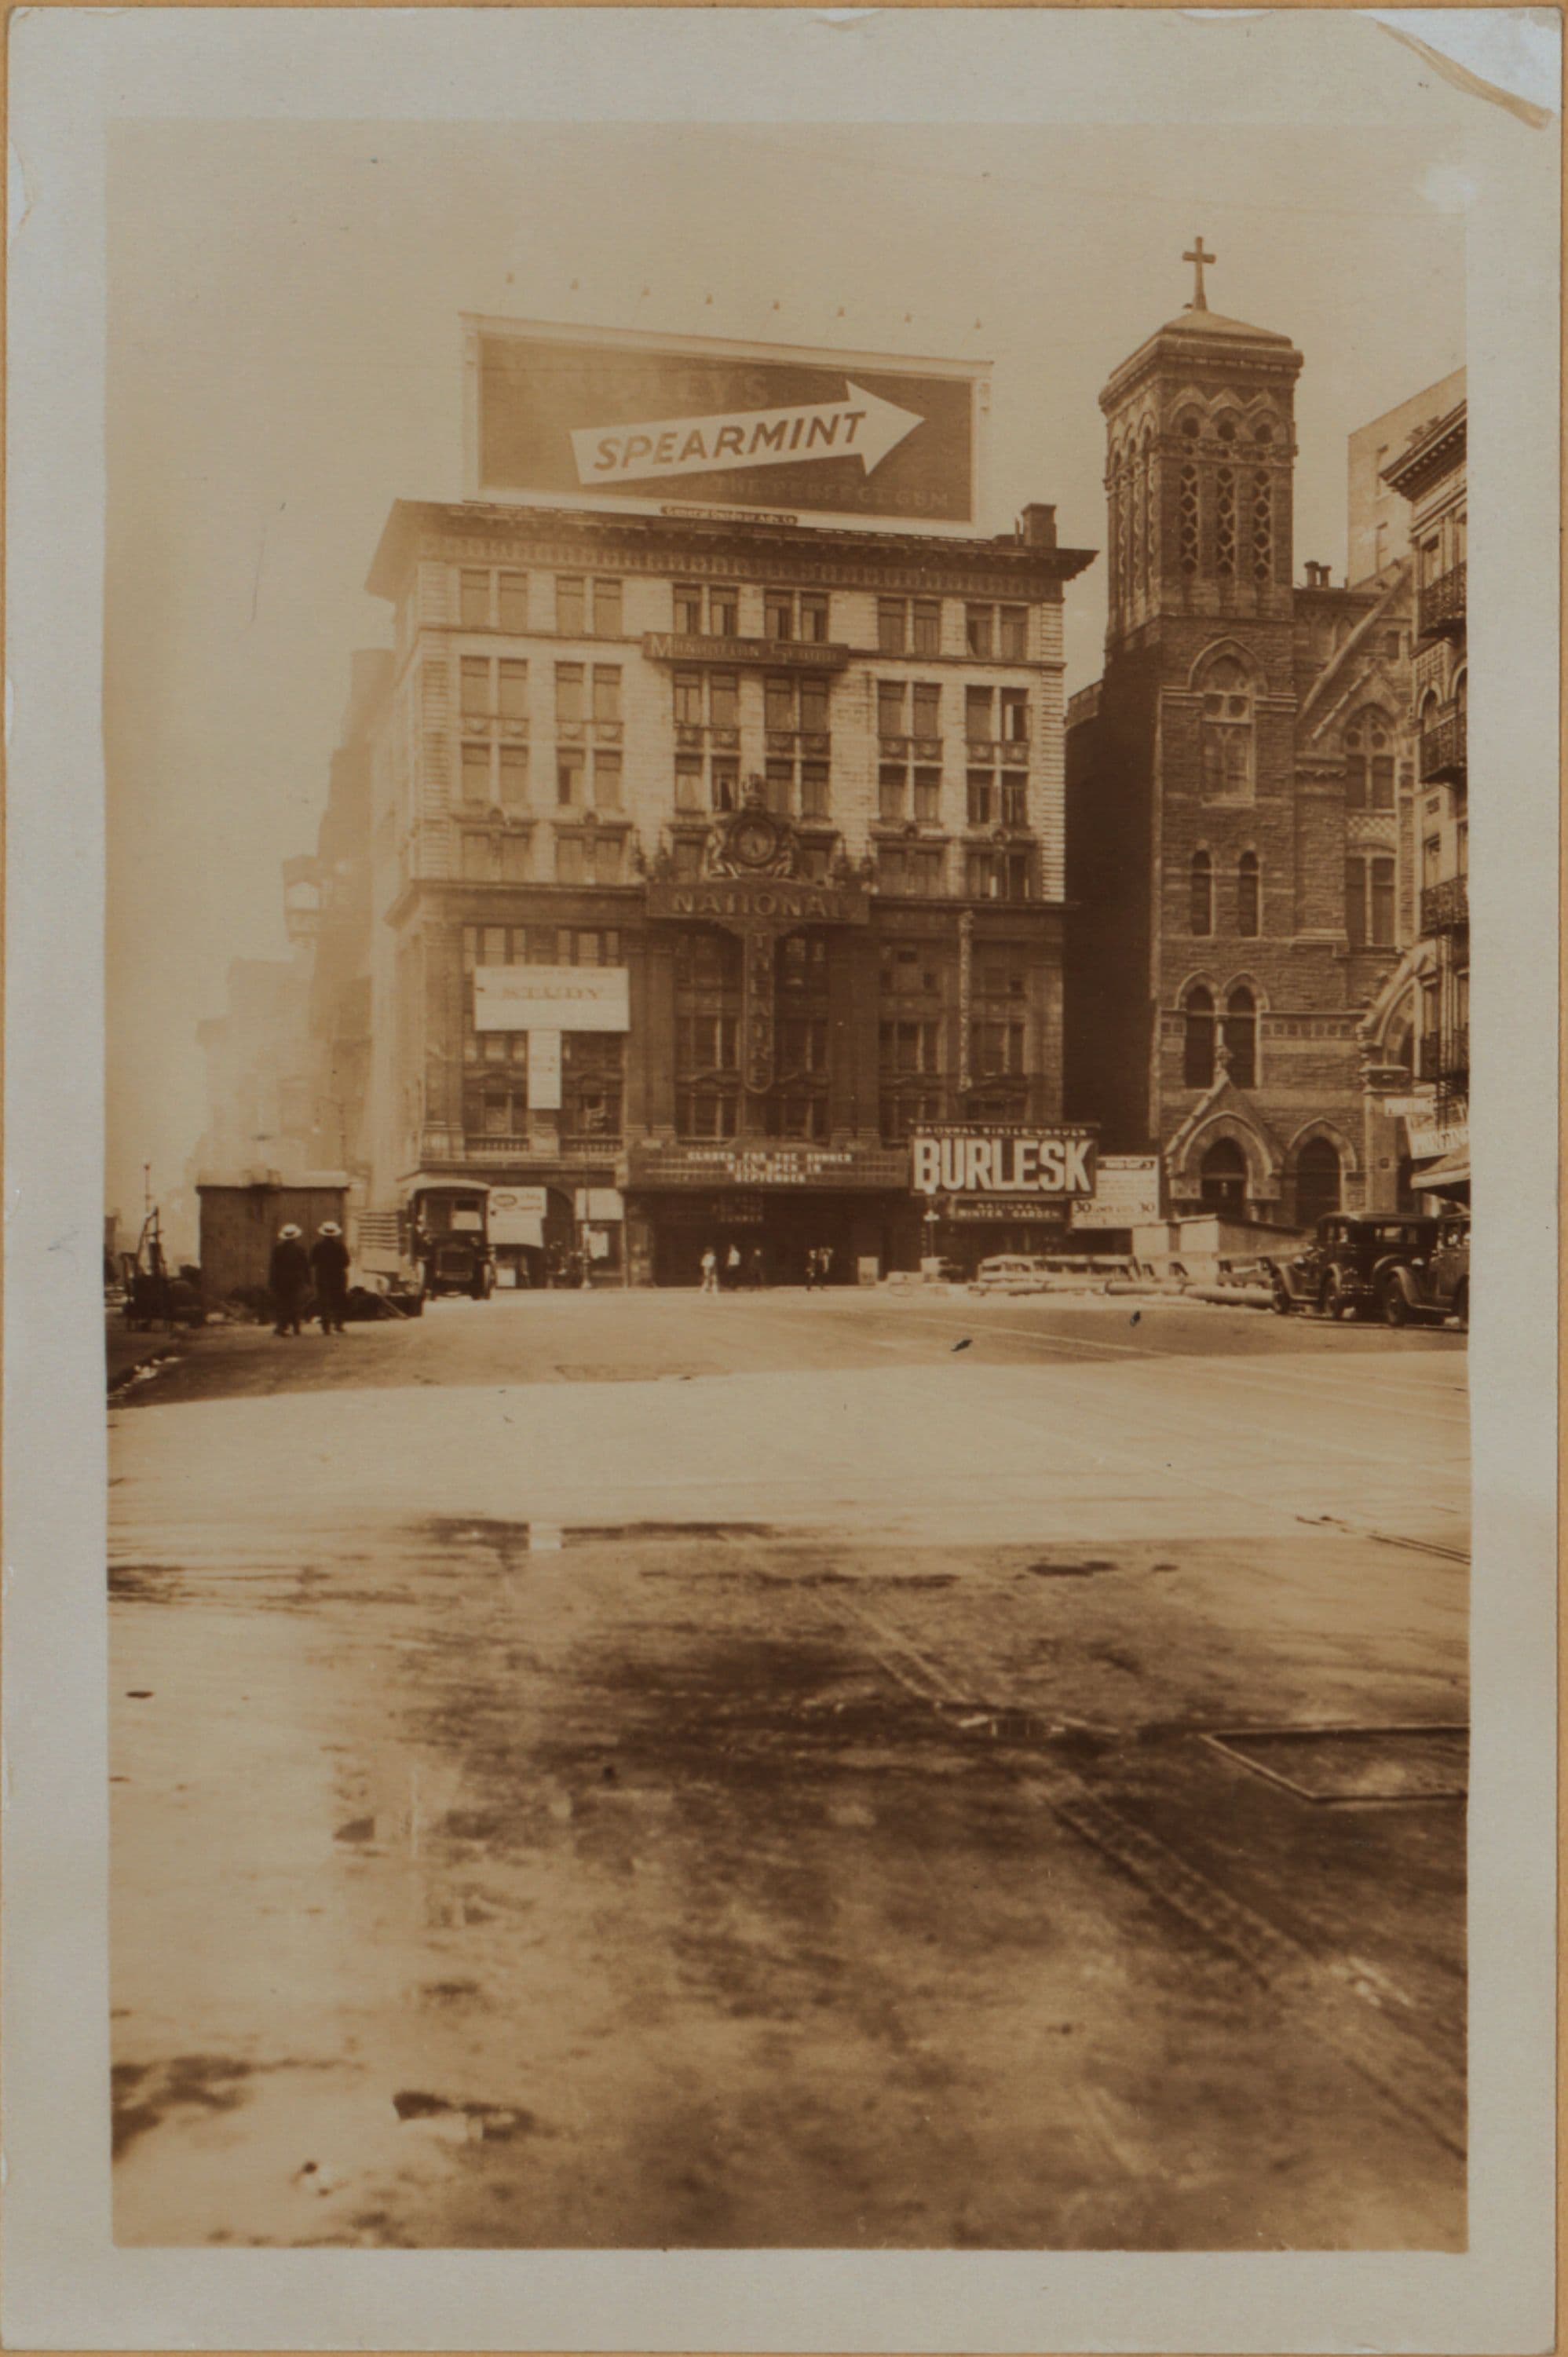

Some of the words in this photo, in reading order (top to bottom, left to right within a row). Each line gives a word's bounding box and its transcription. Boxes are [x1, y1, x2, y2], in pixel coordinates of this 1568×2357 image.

[593, 411, 866, 473] SPEARMINT
[672, 892, 847, 919] NATIONAL
[774, 1152, 798, 1162] THE
[914, 1138, 1092, 1193] BURLESK
